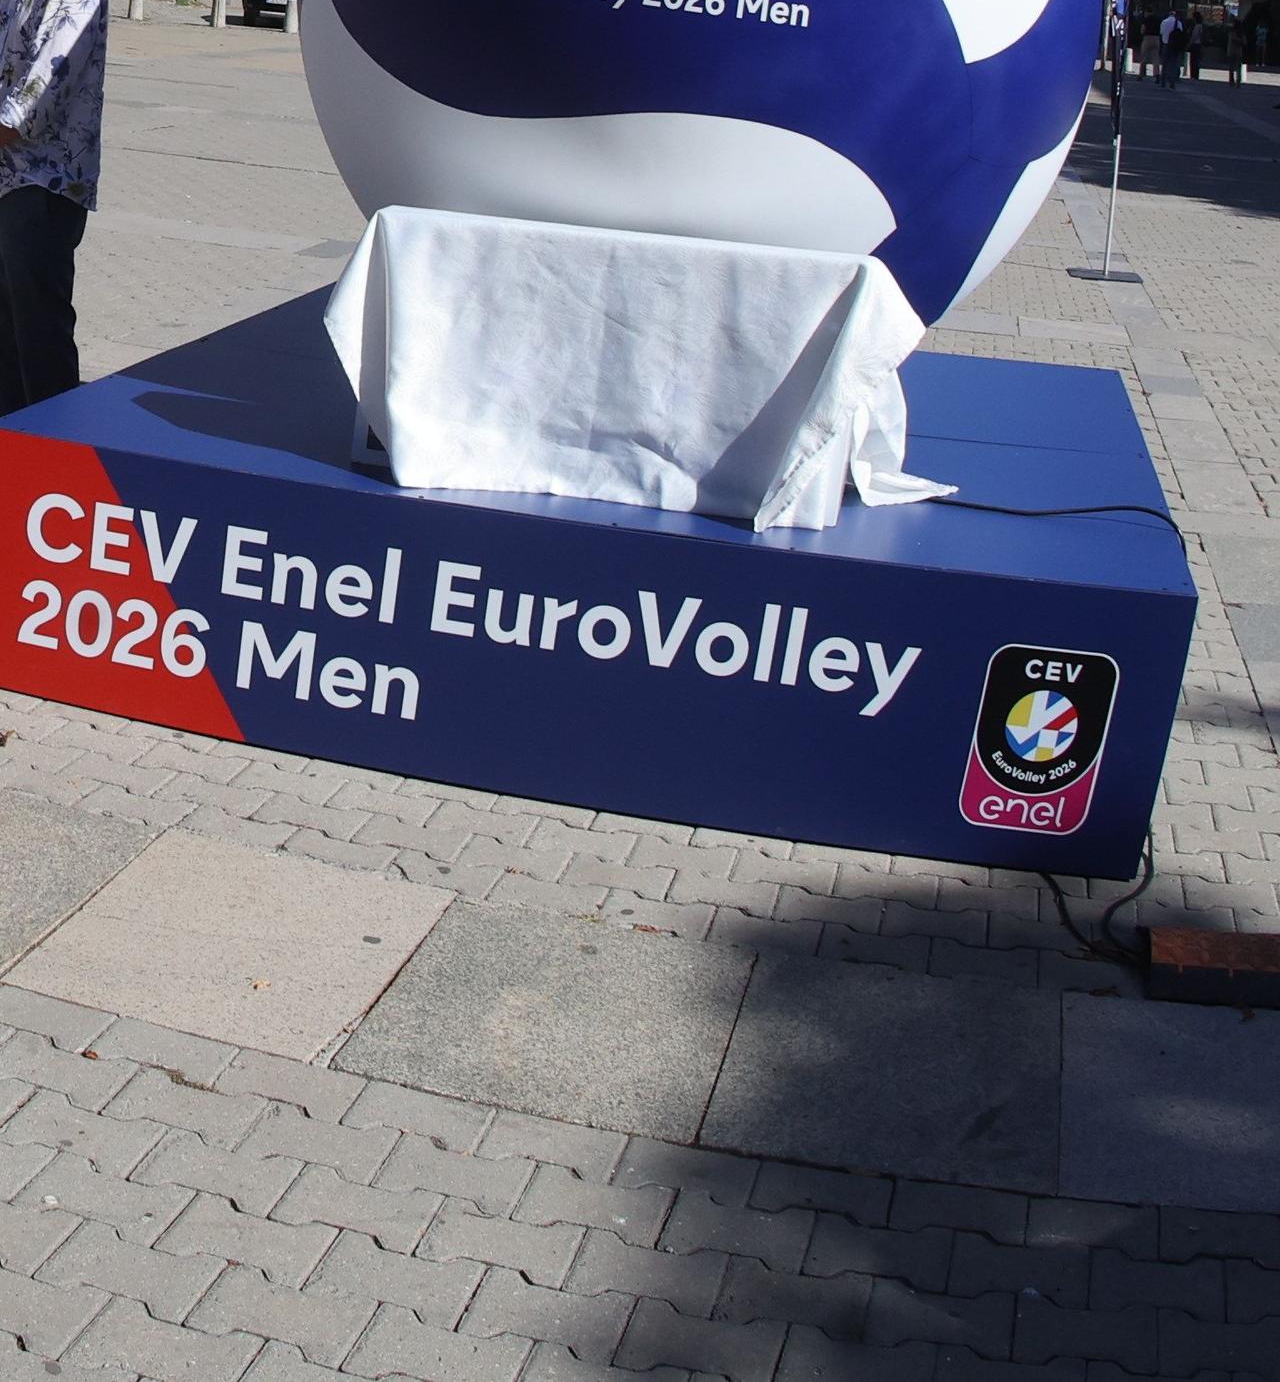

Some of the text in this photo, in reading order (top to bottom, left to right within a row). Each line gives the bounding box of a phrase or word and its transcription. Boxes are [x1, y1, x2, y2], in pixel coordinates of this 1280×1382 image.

[26, 493, 923, 718] CEV Enel EuroVolley
[16, 579, 421, 721] 2026 Men
[1024, 659, 1083, 684] CEV
[991, 750, 1078, 785] EuroVolley 2026
[978, 795, 1066, 828] enel
